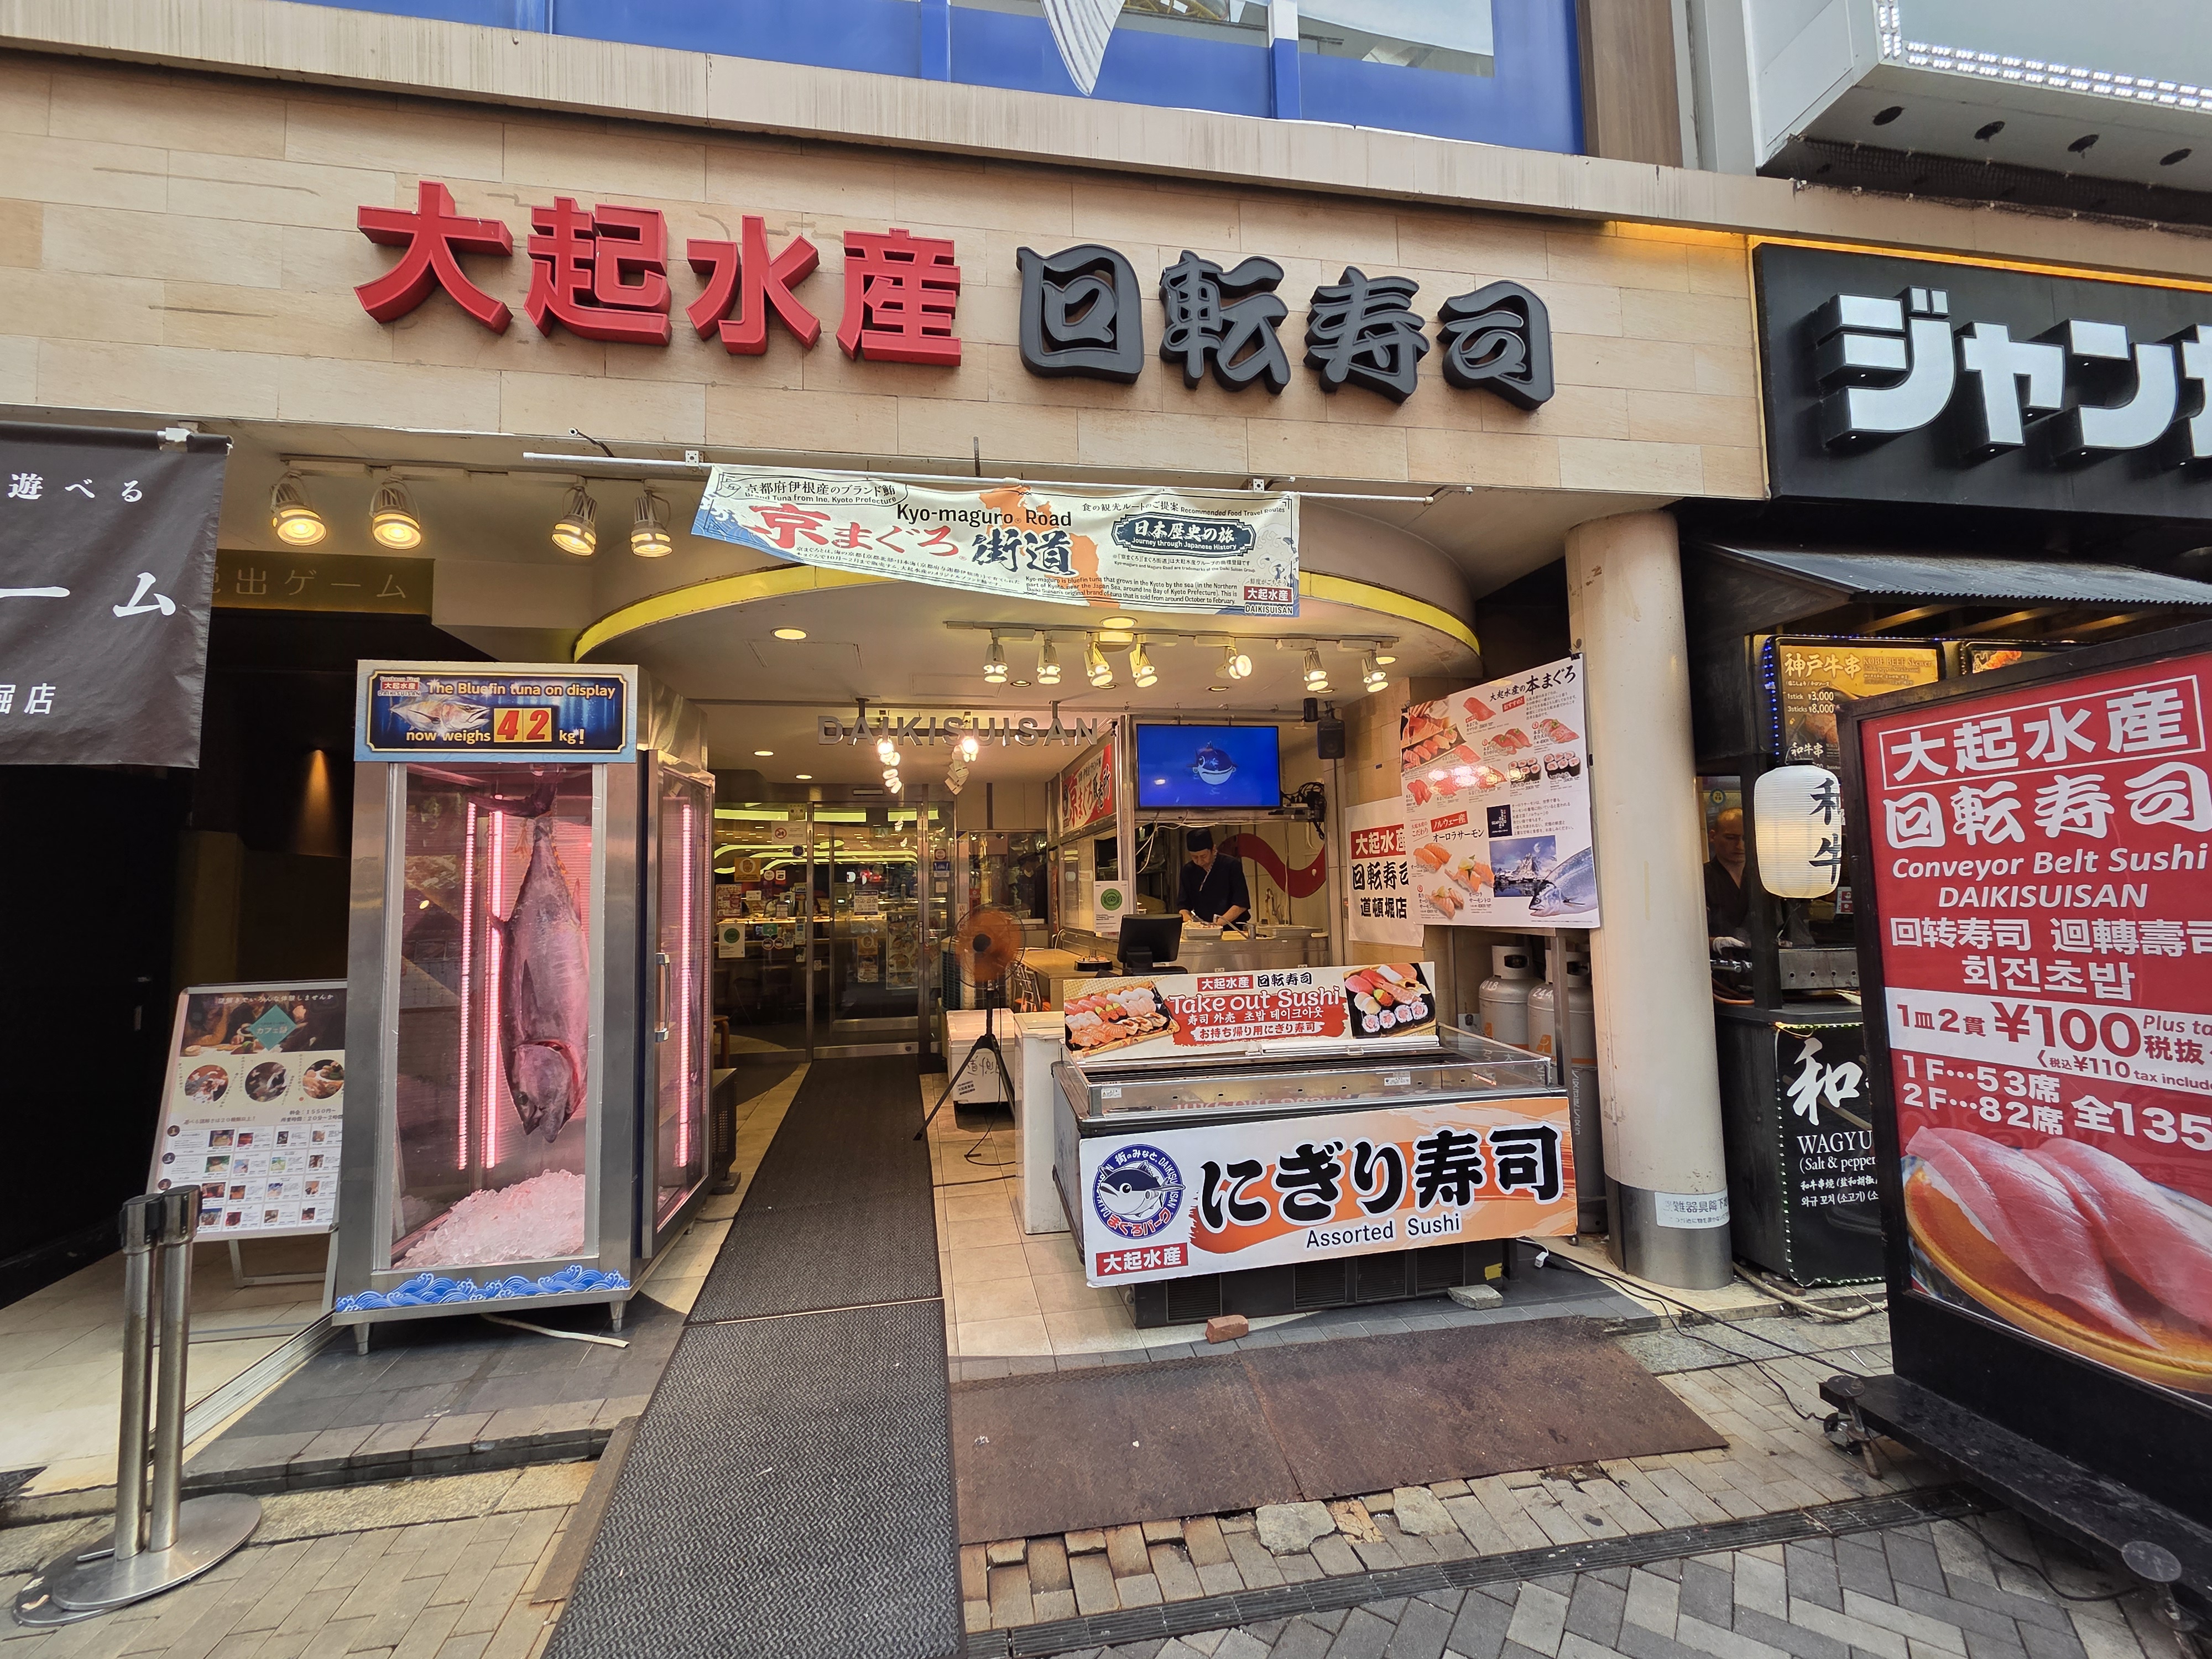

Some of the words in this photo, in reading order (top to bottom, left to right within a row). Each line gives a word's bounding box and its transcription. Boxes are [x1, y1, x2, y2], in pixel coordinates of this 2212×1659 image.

[353, 180, 961, 367] 大起水産
[1016, 243, 1554, 411] 回転寿司
[855, 497, 896, 505] Prefecture
[1082, 500, 1179, 512] 食の観光ルートのご提案
[1181, 506, 1226, 516] Recommended
[1026, 509, 1072, 526] Road
[1134, 520, 1235, 542] 日本歴史の旅
[1132, 537, 1157, 546] Journey
[1157, 539, 1183, 548] through
[1183, 540, 1212, 550] Japanese
[1214, 542, 1237, 550] History
[1150, 581, 1165, 589] Kyoto
[1248, 588, 1288, 601] 大起水産
[1245, 605, 1292, 614] DAIKISUISAN
[1785, 653, 1861, 680] 神戸牛串
[1863, 656, 1885, 665] KOBE
[1886, 657, 1906, 666] BEEF
[1908, 658, 1932, 667] Skewer
[426, 681, 453, 695] The
[458, 682, 505, 695] Bluefin
[510, 684, 541, 696] tuna
[545, 686, 563, 696] on
[566, 685, 615, 699] display
[1489, 665, 1576, 702] 大起水産の本まぐろ
[1808, 691, 1834, 701] ¥3,000
[1808, 703, 1834, 713] ¥8,000
[406, 731, 436, 742] now
[442, 729, 491, 744] weighs
[497, 710, 550, 740] 42
[818, 716, 1098, 747] DAIKISUISAN
[1890, 688, 2188, 781] 大起水産
[1884, 762, 2212, 848] 回転寿司
[1433, 813, 1466, 830] ノルウェー産
[1356, 828, 1406, 855] 大起水産
[1433, 829, 1485, 842] オーロラサーモン
[1892, 856, 2024, 881] Conveyor
[2033, 849, 2099, 875] Belt
[2108, 843, 2208, 873] Sushi
[1938, 884, 2148, 907] DAIKISUISAN
[1360, 896, 1407, 919] 道頓堀店
[1890, 917, 2032, 952] 回转寿司
[1201, 977, 1250, 990] 大起水産
[1257, 972, 1312, 988] 回転寿司
[1961, 954, 2136, 1001] 회전초밥
[1168, 994, 1226, 1015] Take
[1230, 990, 1271, 1011] out
[1277, 987, 1340, 1010] Sushi
[1187, 1014, 1209, 1026] 寿司
[1244, 1009, 1266, 1021] 초밥
[1270, 1006, 1324, 1021] 테이크아웃
[1199, 1022, 1316, 1040] お持ち帰り用にぎり寿司
[1991, 1001, 2141, 1058] ¥100
[2143, 1015, 2185, 1033] Plus
[1787, 1037, 1870, 1126] 和
[2133, 1070, 2158, 1083] tax
[1797, 1130, 1873, 1155] WAGYU
[1115, 1149, 1157, 1166] 街のみなと
[1799, 1156, 1825, 1175] (Salt
[1828, 1156, 1839, 1168] &
[1841, 1156, 1876, 1172] pepper
[1199, 1125, 1559, 1230] にぎり寿司
[1801, 1196, 1818, 1207] 와규
[1107, 1207, 1171, 1237] まぐろパーク
[1306, 1225, 1394, 1249] Assorted
[1407, 1215, 1461, 1235] Sushi
[1103, 1246, 1182, 1274] 大起水産
